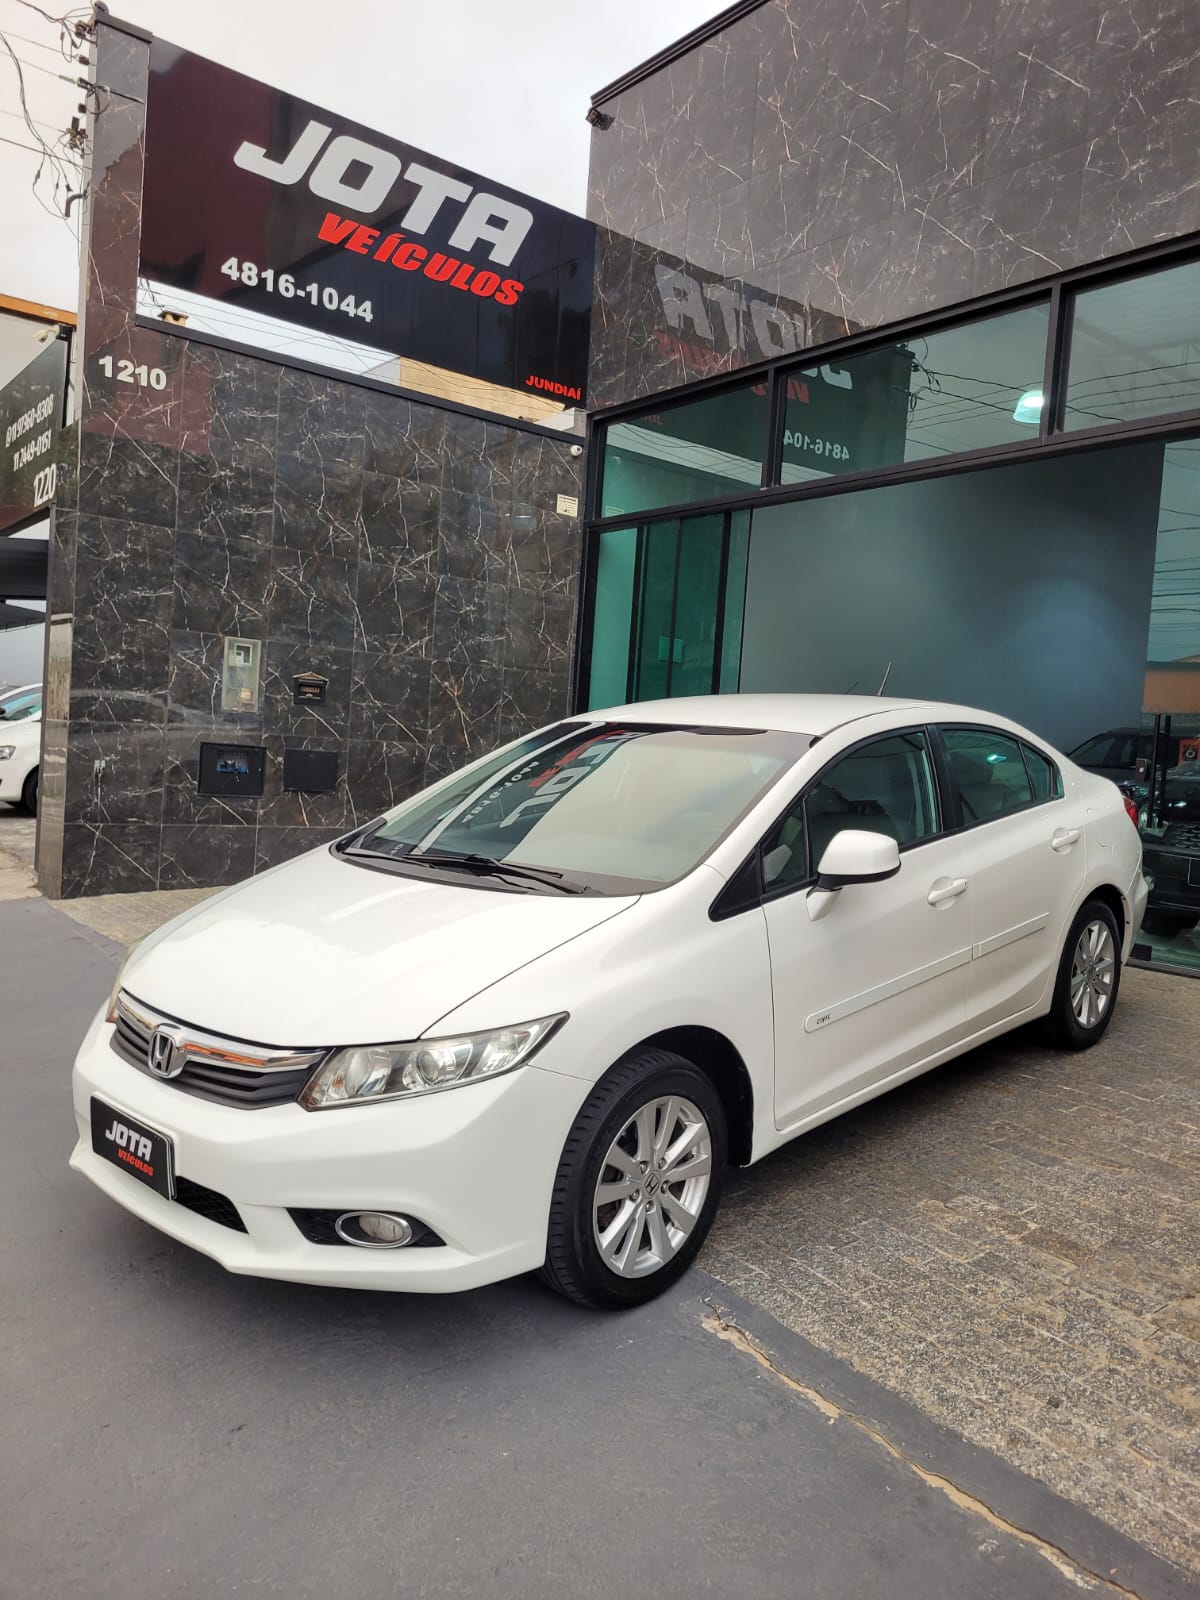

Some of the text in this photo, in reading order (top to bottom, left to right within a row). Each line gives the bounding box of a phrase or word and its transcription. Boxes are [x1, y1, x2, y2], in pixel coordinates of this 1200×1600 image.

[233, 119, 534, 267] JOTA
[318, 212, 524, 306] VEÍCULOS
[220, 257, 374, 323] 4816-1044
[98, 355, 167, 391] 1210
[525, 375, 582, 400] JUNDIAÍ
[33, 462, 57, 508] 1220
[105, 1119, 153, 1162] JOTA
